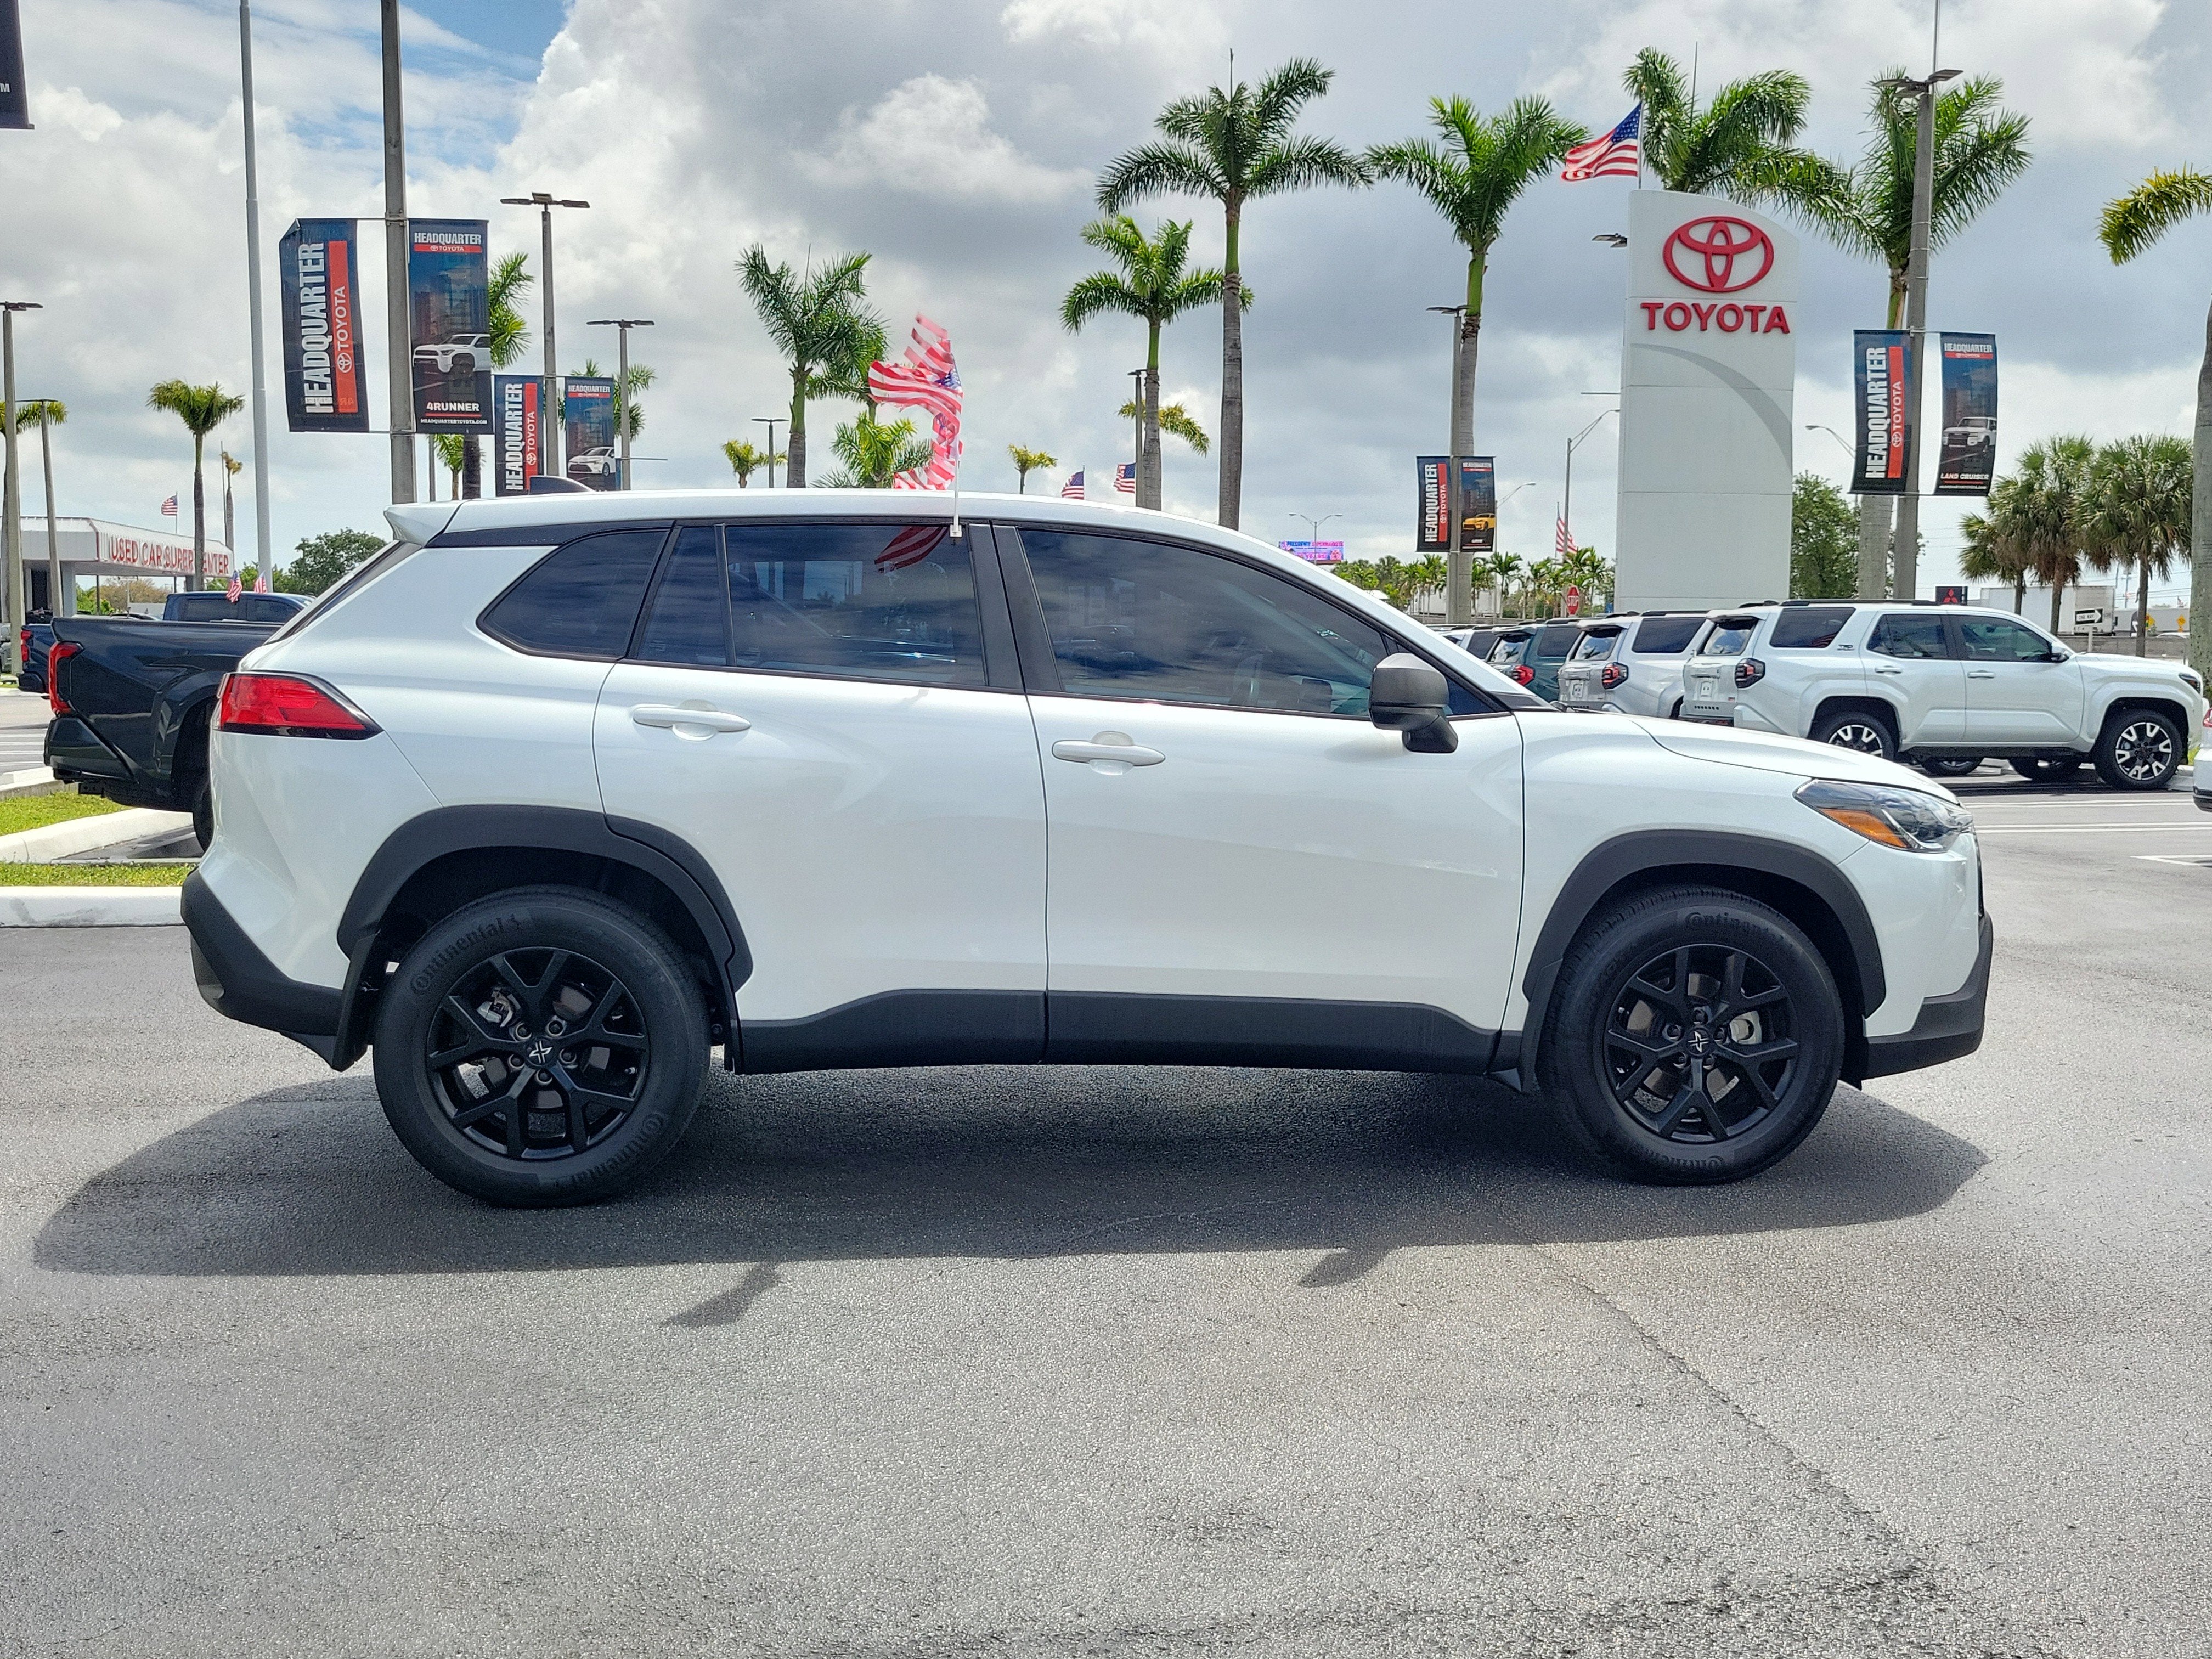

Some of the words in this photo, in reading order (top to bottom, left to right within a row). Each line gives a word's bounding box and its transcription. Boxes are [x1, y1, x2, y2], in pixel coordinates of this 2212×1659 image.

[414, 232, 482, 245] HEADQUARTER
[298, 242, 334, 413] HEADQUARTER
[334, 286, 350, 351] TOYOTA
[1640, 302, 1790, 334] TOYOTA
[1944, 343, 1993, 353] HEADQUARTER
[426, 402, 480, 411] 4RUNNER
[568, 385, 610, 393] HEADQUARTER
[1892, 381, 1903, 431] TOYOTA
[527, 411, 535, 452] TOYOTA
[1865, 347, 1891, 478] HEADQUARTER
[505, 383, 525, 490] HEADQUARTER
[1424, 464, 1440, 542] HEADQUARTER
[111, 537, 138, 563] USED
[141, 541, 163, 566] CAR
[165, 545, 195, 571] SUPER
[202, 551, 229, 574] ENTER
[1567, 595, 1579, 607] STOP
[410, 917, 505, 995] Continental
